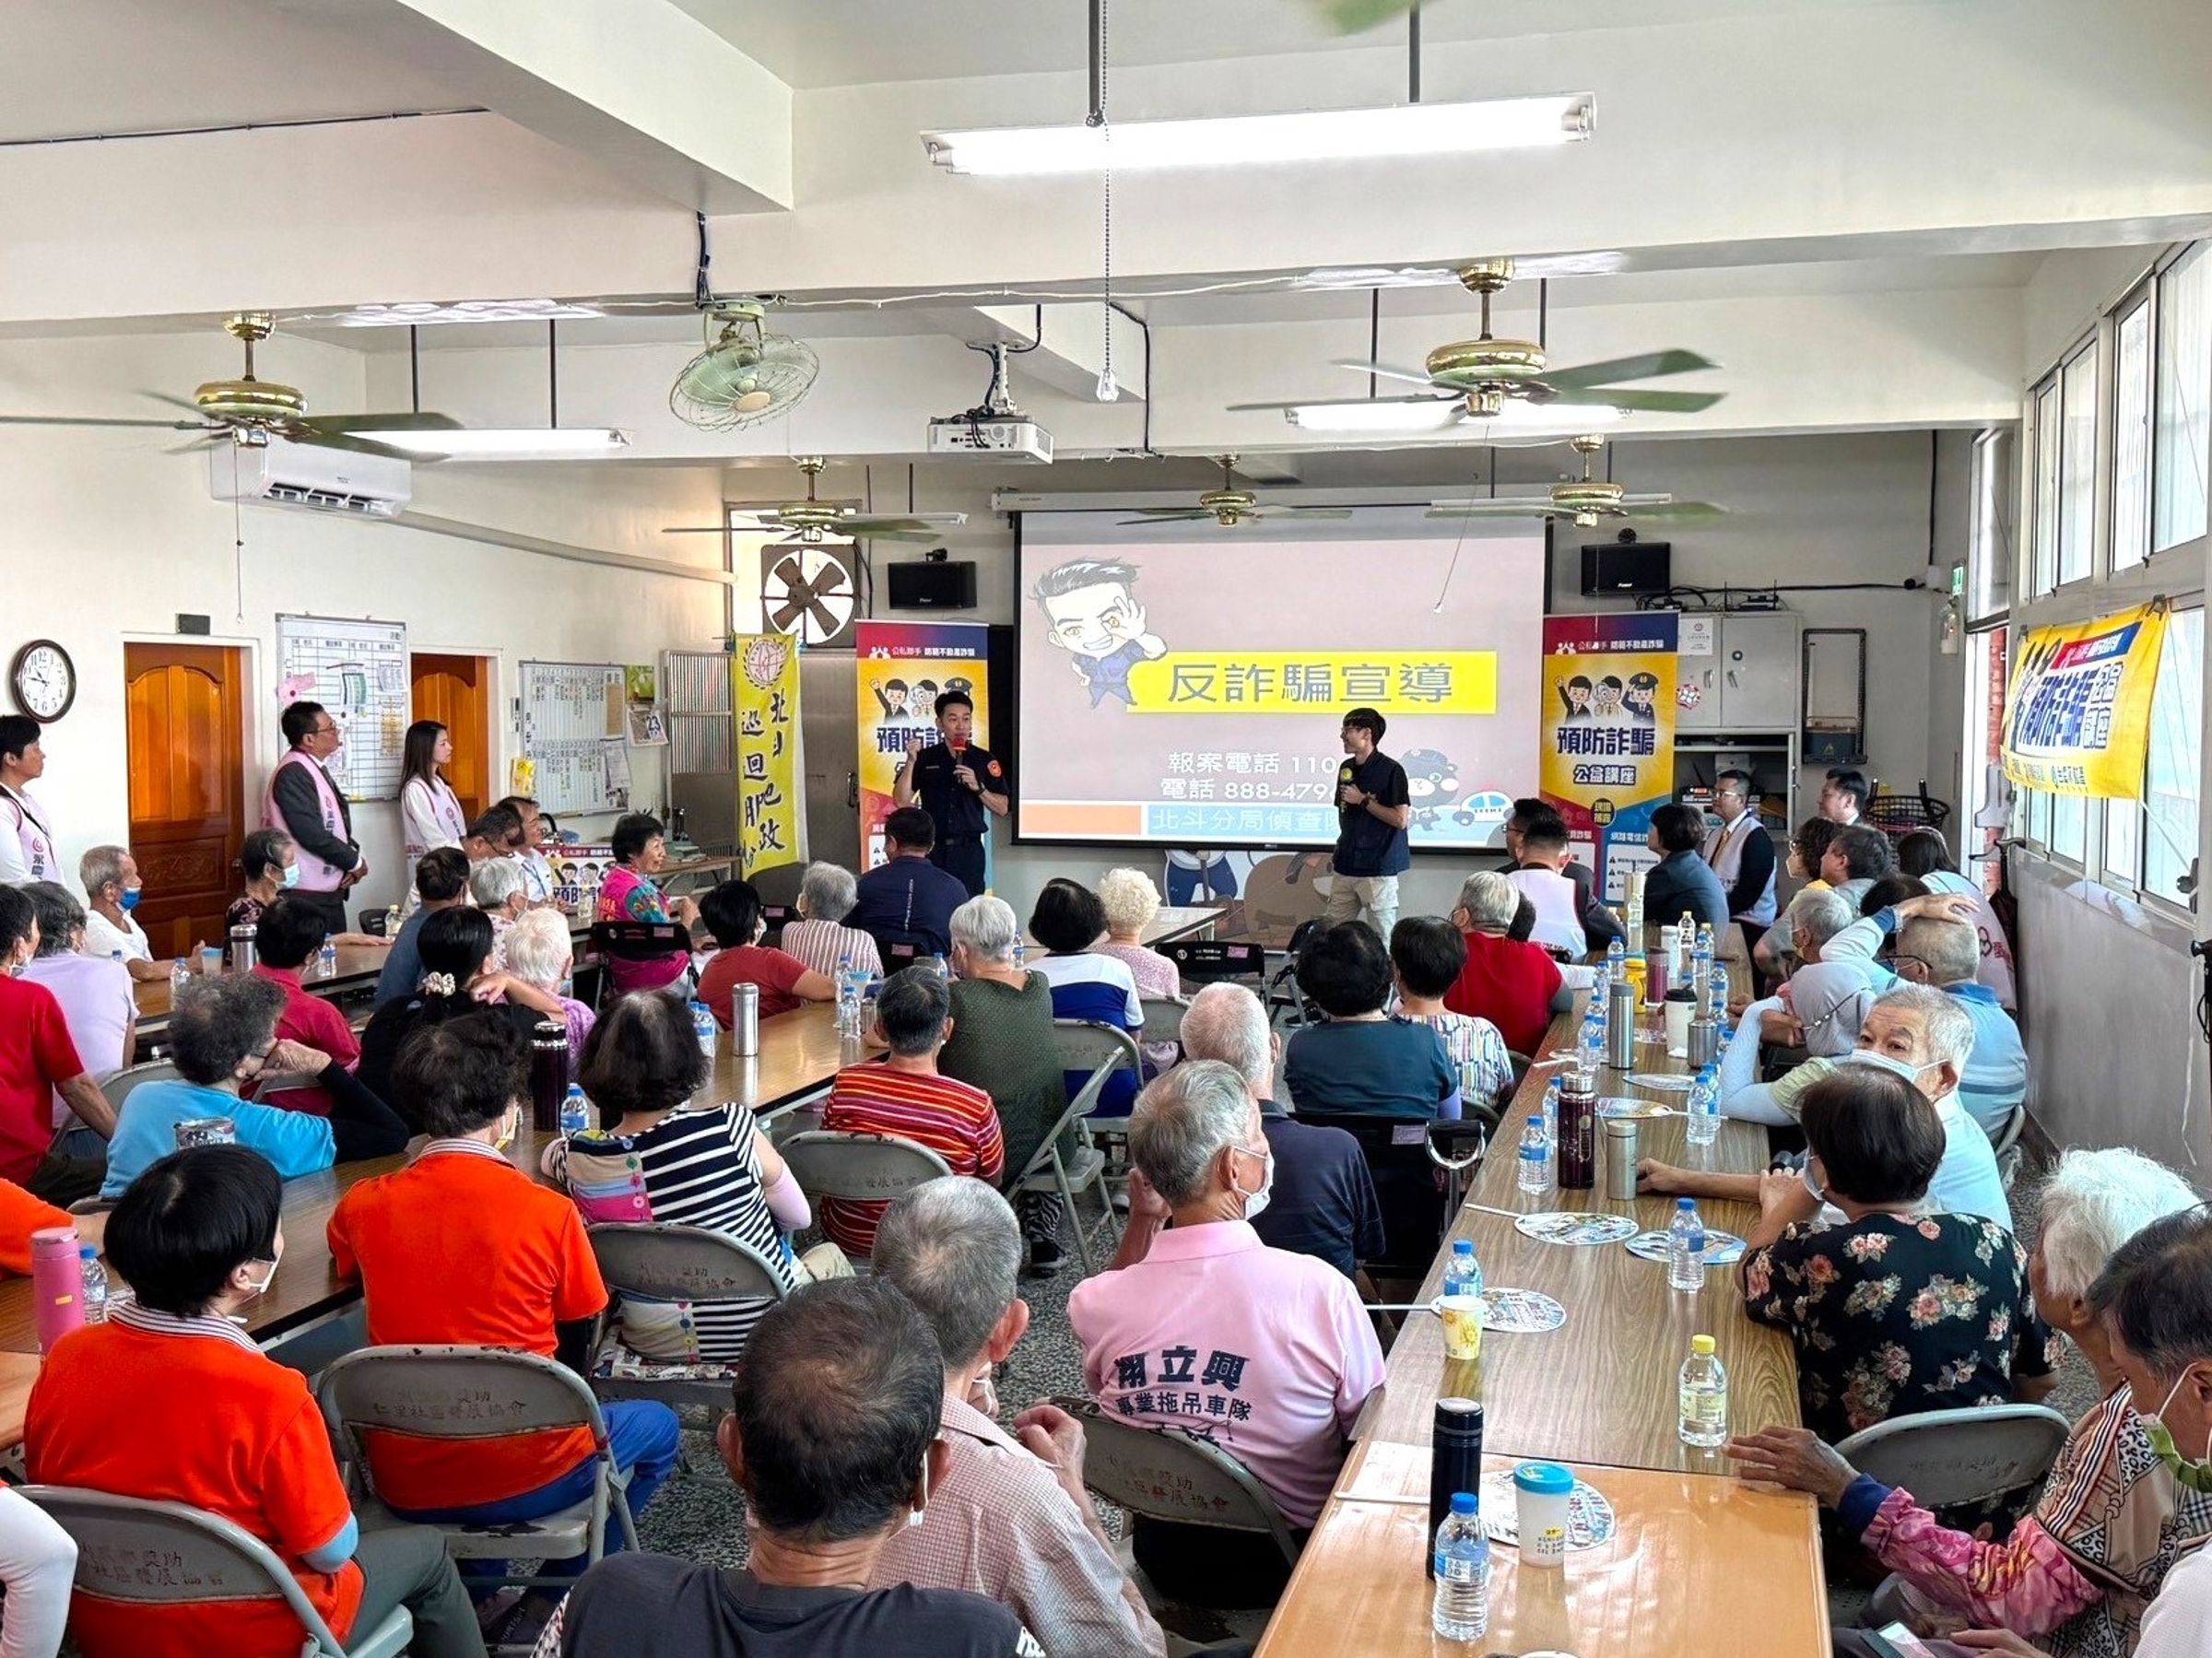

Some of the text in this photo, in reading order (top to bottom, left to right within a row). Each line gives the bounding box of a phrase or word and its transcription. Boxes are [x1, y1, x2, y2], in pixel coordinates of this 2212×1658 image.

[1168, 663, 1453, 703] 反詐騙宣導
[646, 715, 661, 731] 23
[877, 727, 971, 753] 預防詐
[1557, 726, 1656, 756] 預防詐騙
[1168, 752, 1336, 774] 報案電話 110
[1573, 764, 1636, 785] 公益講座
[1160, 778, 1336, 800] 電話 888-479
